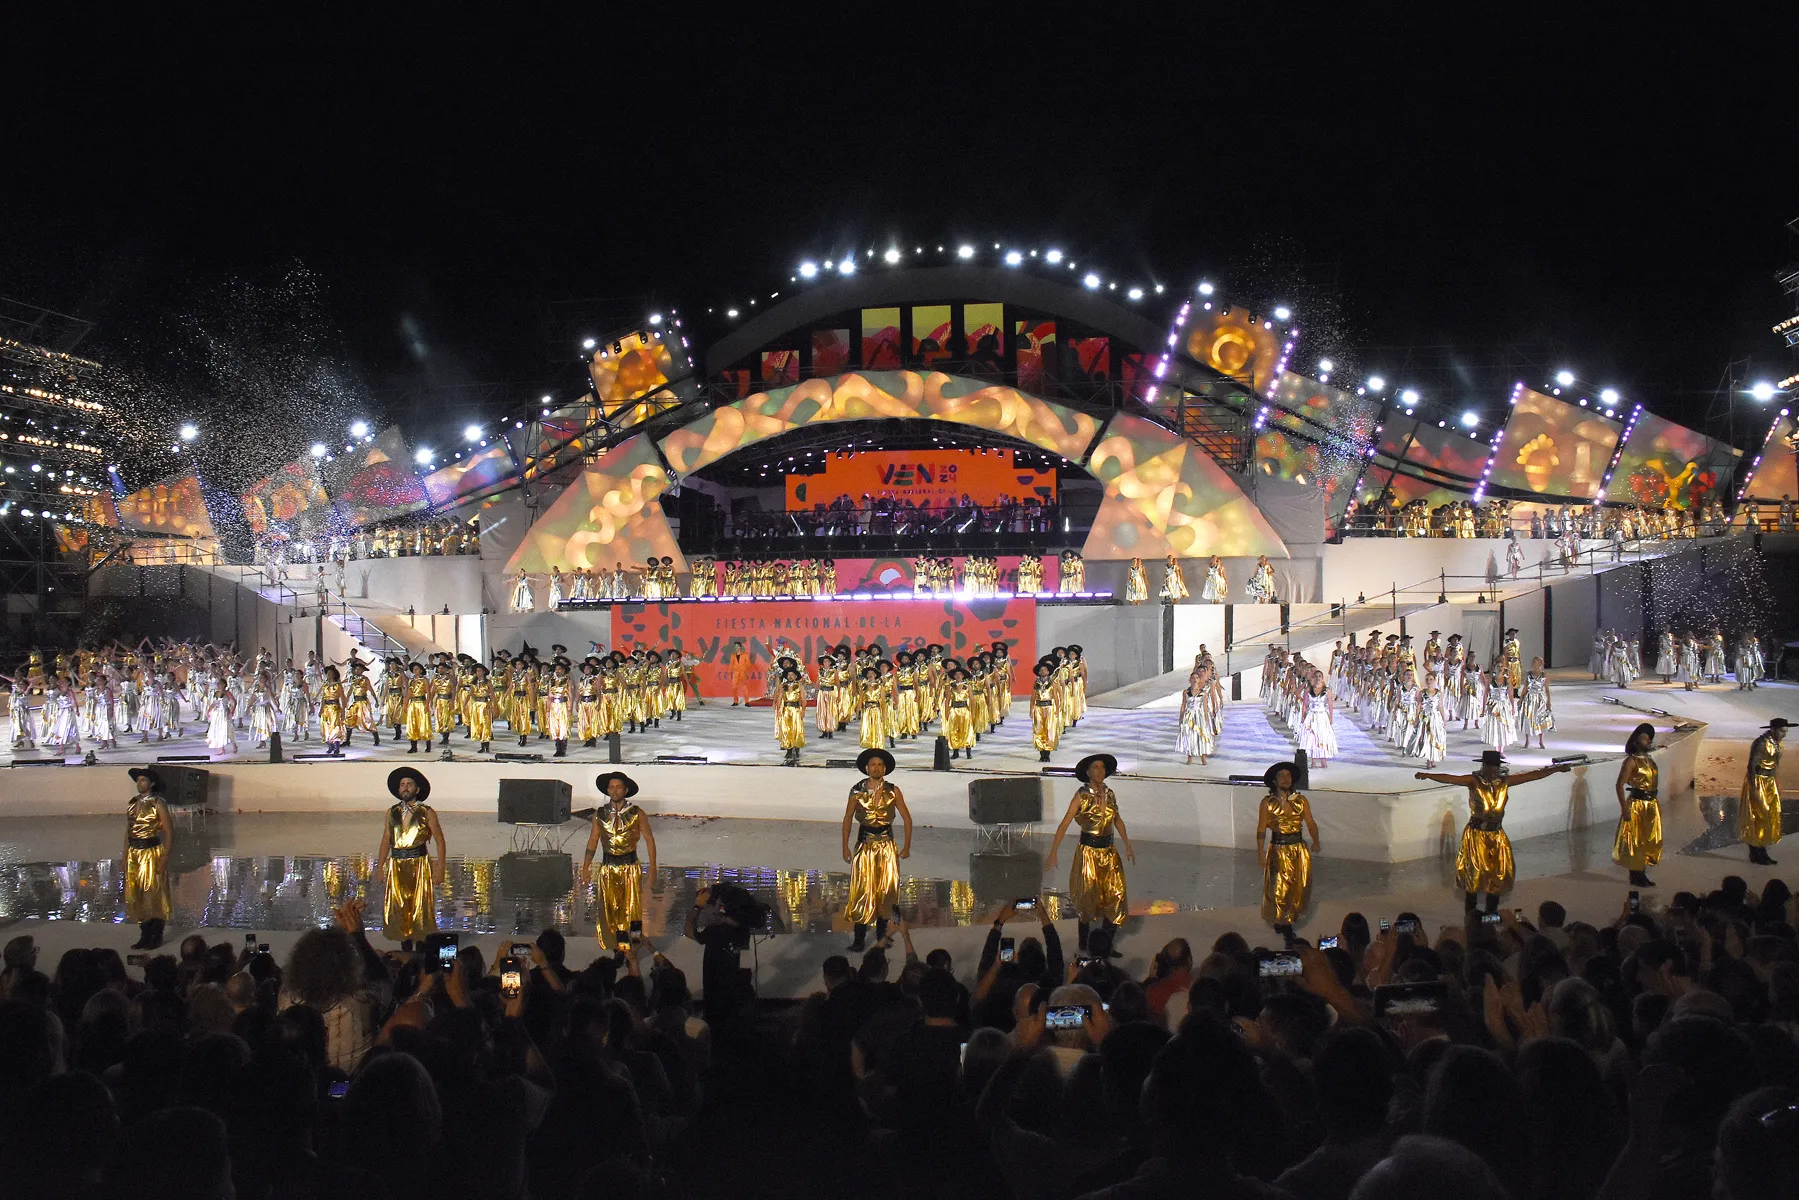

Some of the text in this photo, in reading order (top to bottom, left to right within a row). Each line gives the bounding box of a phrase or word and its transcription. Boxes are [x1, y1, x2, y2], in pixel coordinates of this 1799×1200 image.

[876, 463, 936, 486] VEN
[716, 616, 902, 630] FIESTA NACIONAL DE LA
